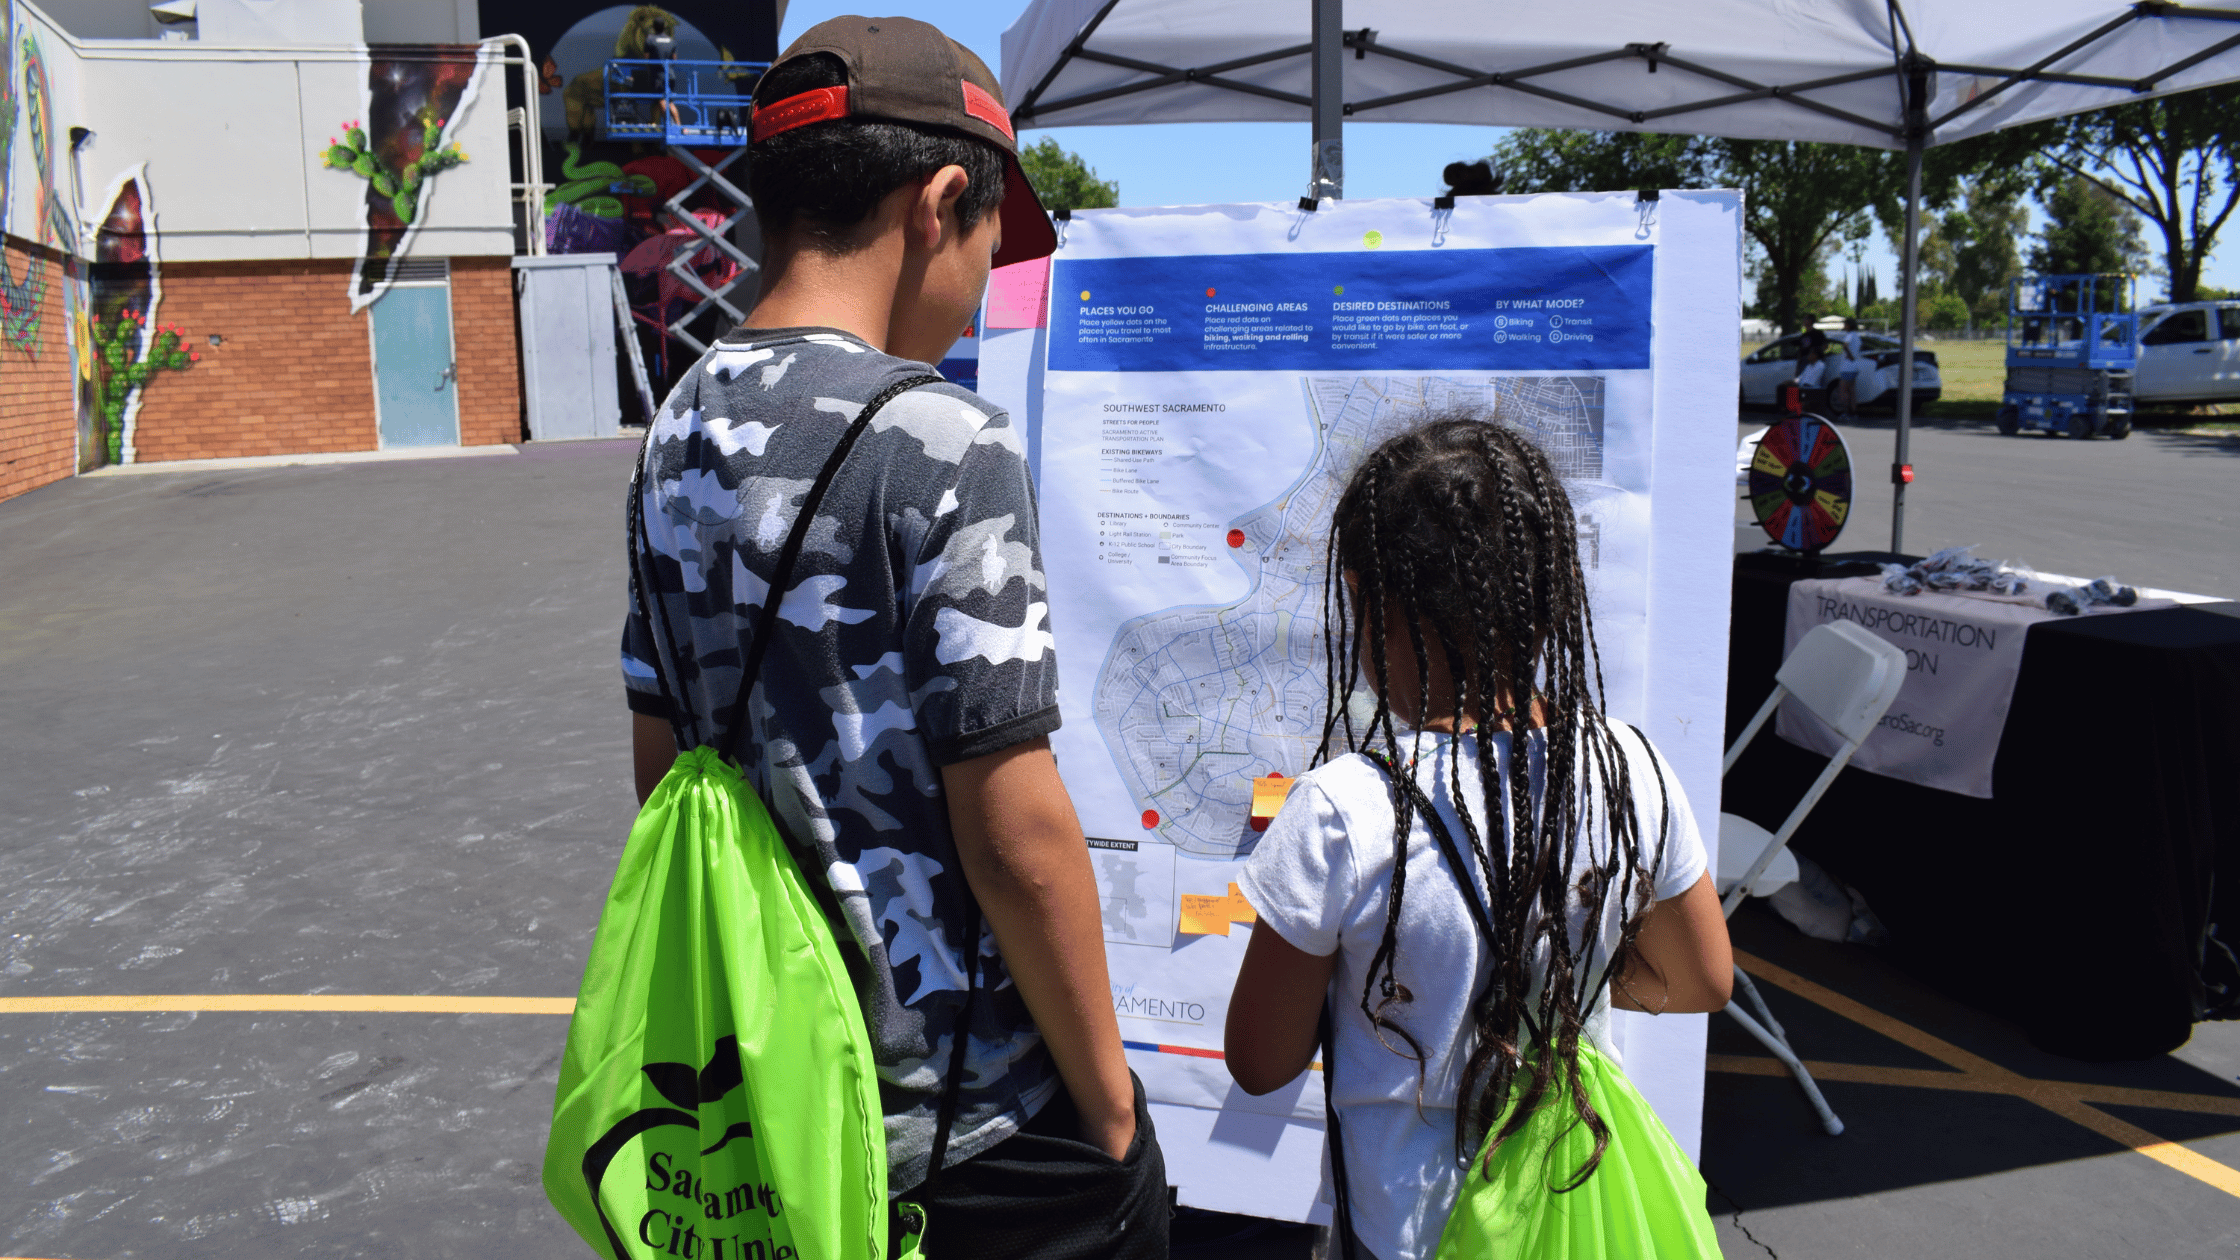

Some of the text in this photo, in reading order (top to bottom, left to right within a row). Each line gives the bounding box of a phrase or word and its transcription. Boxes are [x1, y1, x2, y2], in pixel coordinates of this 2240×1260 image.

[1205, 303, 1308, 313] CHALLENGING AREAS
[1333, 301, 1450, 311] DESIRED DESTINATIONS
[1496, 299, 1585, 309] BY WHAT MODE?
[1080, 306, 1154, 315] PLACES YOU GO
[1102, 319, 1124, 327] yellow
[1333, 314, 1354, 322] Place
[1356, 315, 1380, 323] green
[1382, 314, 1399, 322] dots
[1413, 314, 1441, 322] places
[1443, 315, 1458, 323] you
[1509, 318, 1534, 327] Biking
[1079, 327, 1104, 336] places
[1106, 328, 1119, 336] you
[1204, 325, 1250, 334] challenging
[1275, 324, 1304, 332] related
[1332, 323, 1356, 331] would
[1395, 323, 1405, 332] by
[1204, 333, 1309, 343] biking, walking and rolling
[1332, 333, 1341, 342] by
[1371, 332, 1376, 340] if
[1378, 332, 1383, 340] it
[1407, 332, 1428, 340] safer
[1508, 333, 1541, 342] Walking
[1564, 333, 1593, 342] Driving
[1103, 404, 1226, 412] SOUTHWEST SACRAMENTO
[1817, 595, 1996, 650] TRANSPORTATION
[1112, 982, 1137, 997] ity of
[1115, 996, 1204, 1020] AMENTO
